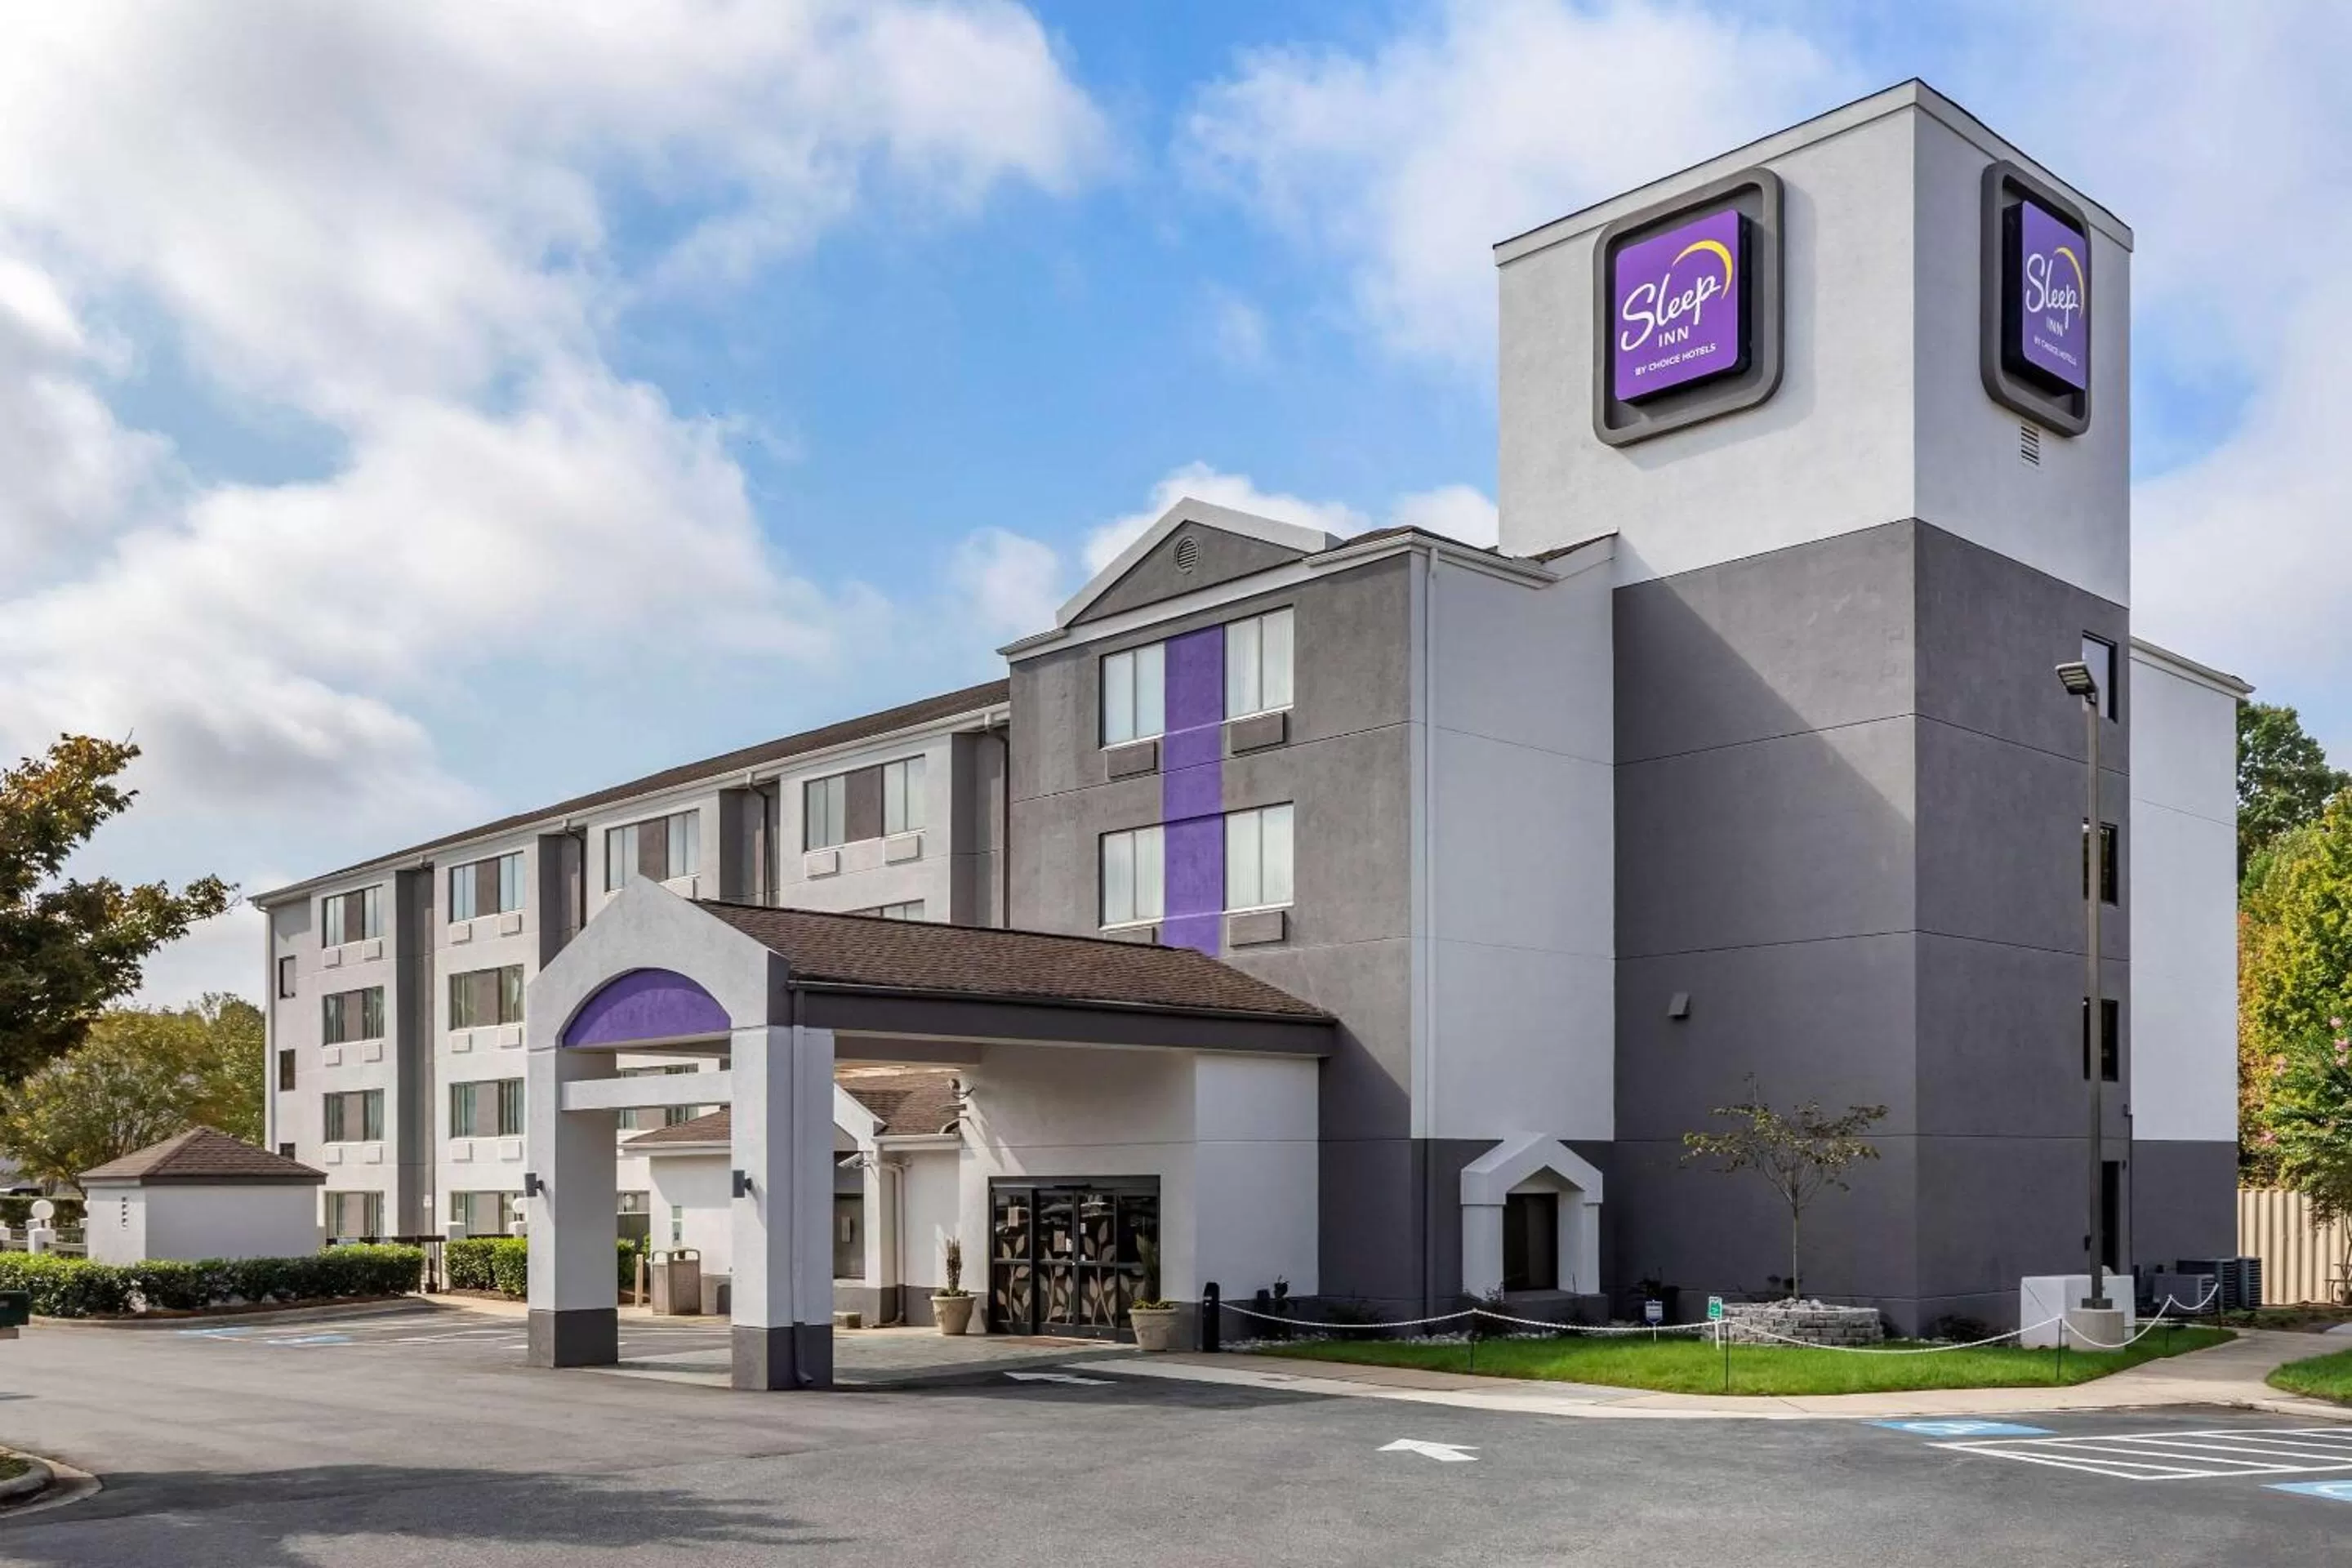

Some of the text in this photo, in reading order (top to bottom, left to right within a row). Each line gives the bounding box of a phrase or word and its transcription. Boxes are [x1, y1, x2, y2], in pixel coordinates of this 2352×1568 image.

[2025, 252, 2079, 330] Sleep
[1620, 273, 1721, 352] Sleep
[2046, 315, 2064, 337] INN
[1658, 325, 1690, 348] INN
[1635, 342, 1717, 376] BY CHOICE HOTELS
